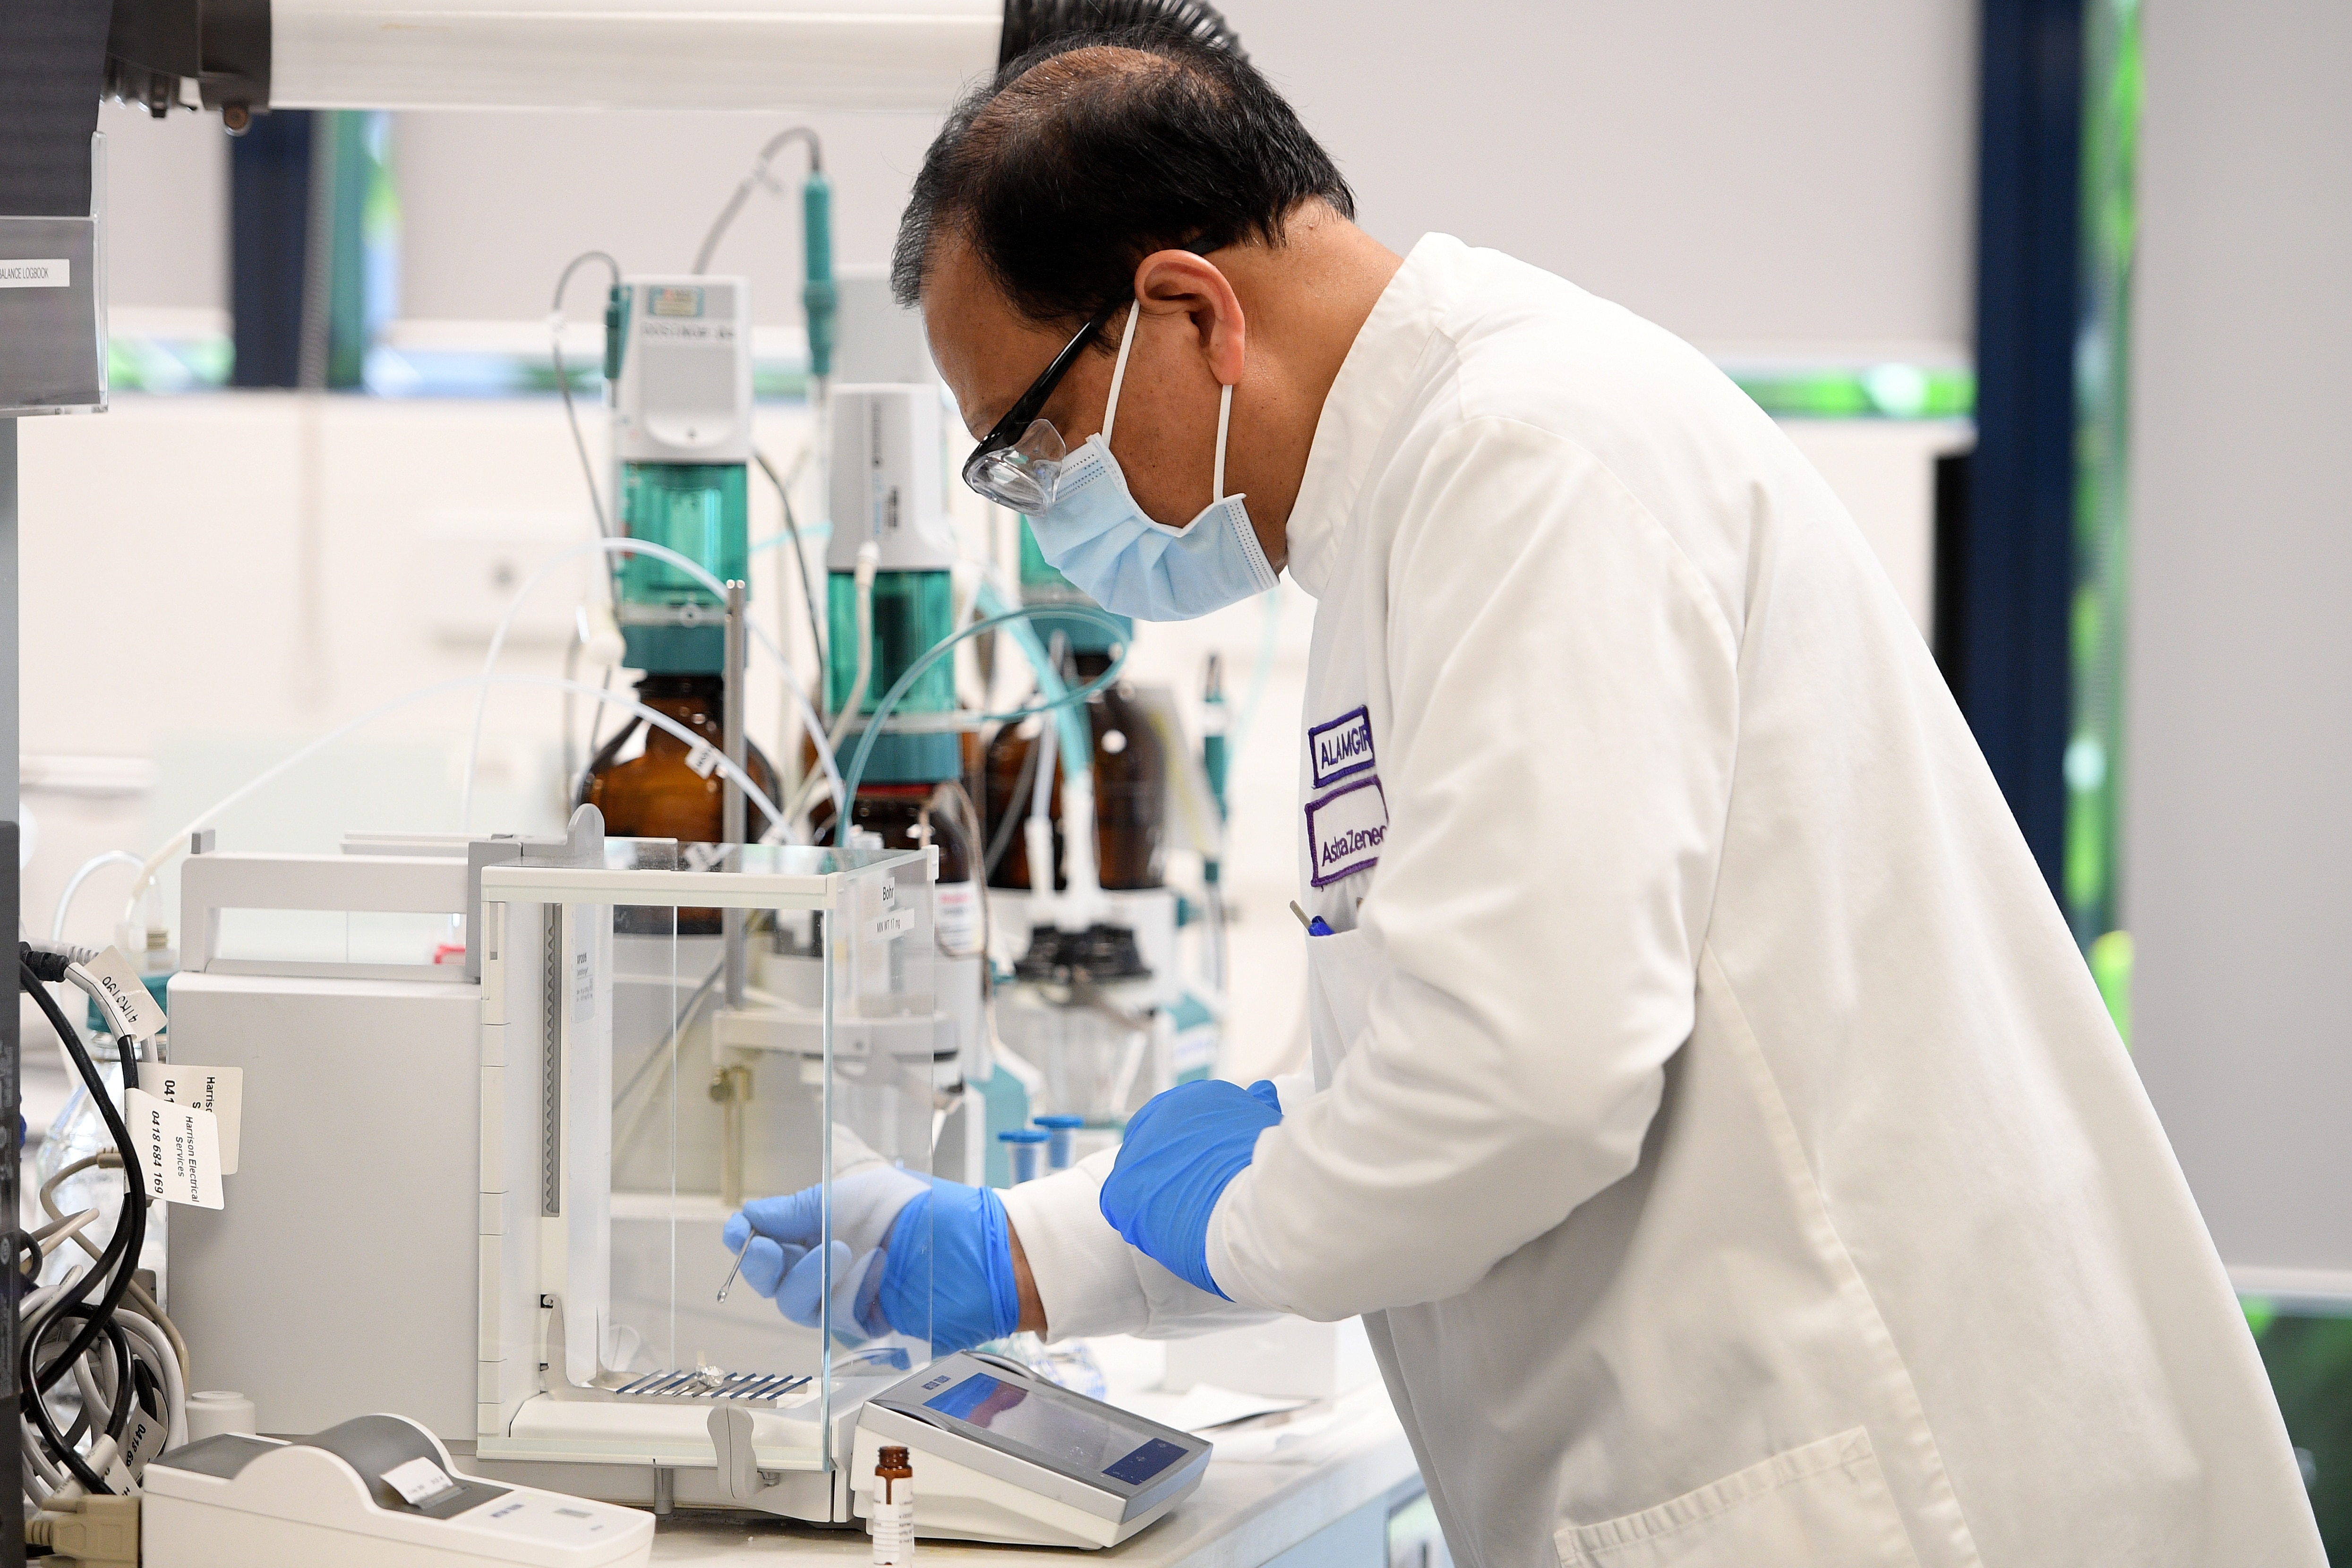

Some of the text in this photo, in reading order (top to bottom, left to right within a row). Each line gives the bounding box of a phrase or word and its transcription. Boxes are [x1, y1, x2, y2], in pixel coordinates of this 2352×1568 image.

[23, 266, 49, 279] LOGBOOK
[1321, 726, 1371, 770] ALAMGIR
[882, 884, 894, 901] Bohr
[884, 919, 889, 931] WT
[895, 919, 900, 930] mg
[151, 1110, 163, 1194] 0418 684 169
[175, 1136, 185, 1177] Services
[185, 1115, 200, 1203] Harrison Electrical
